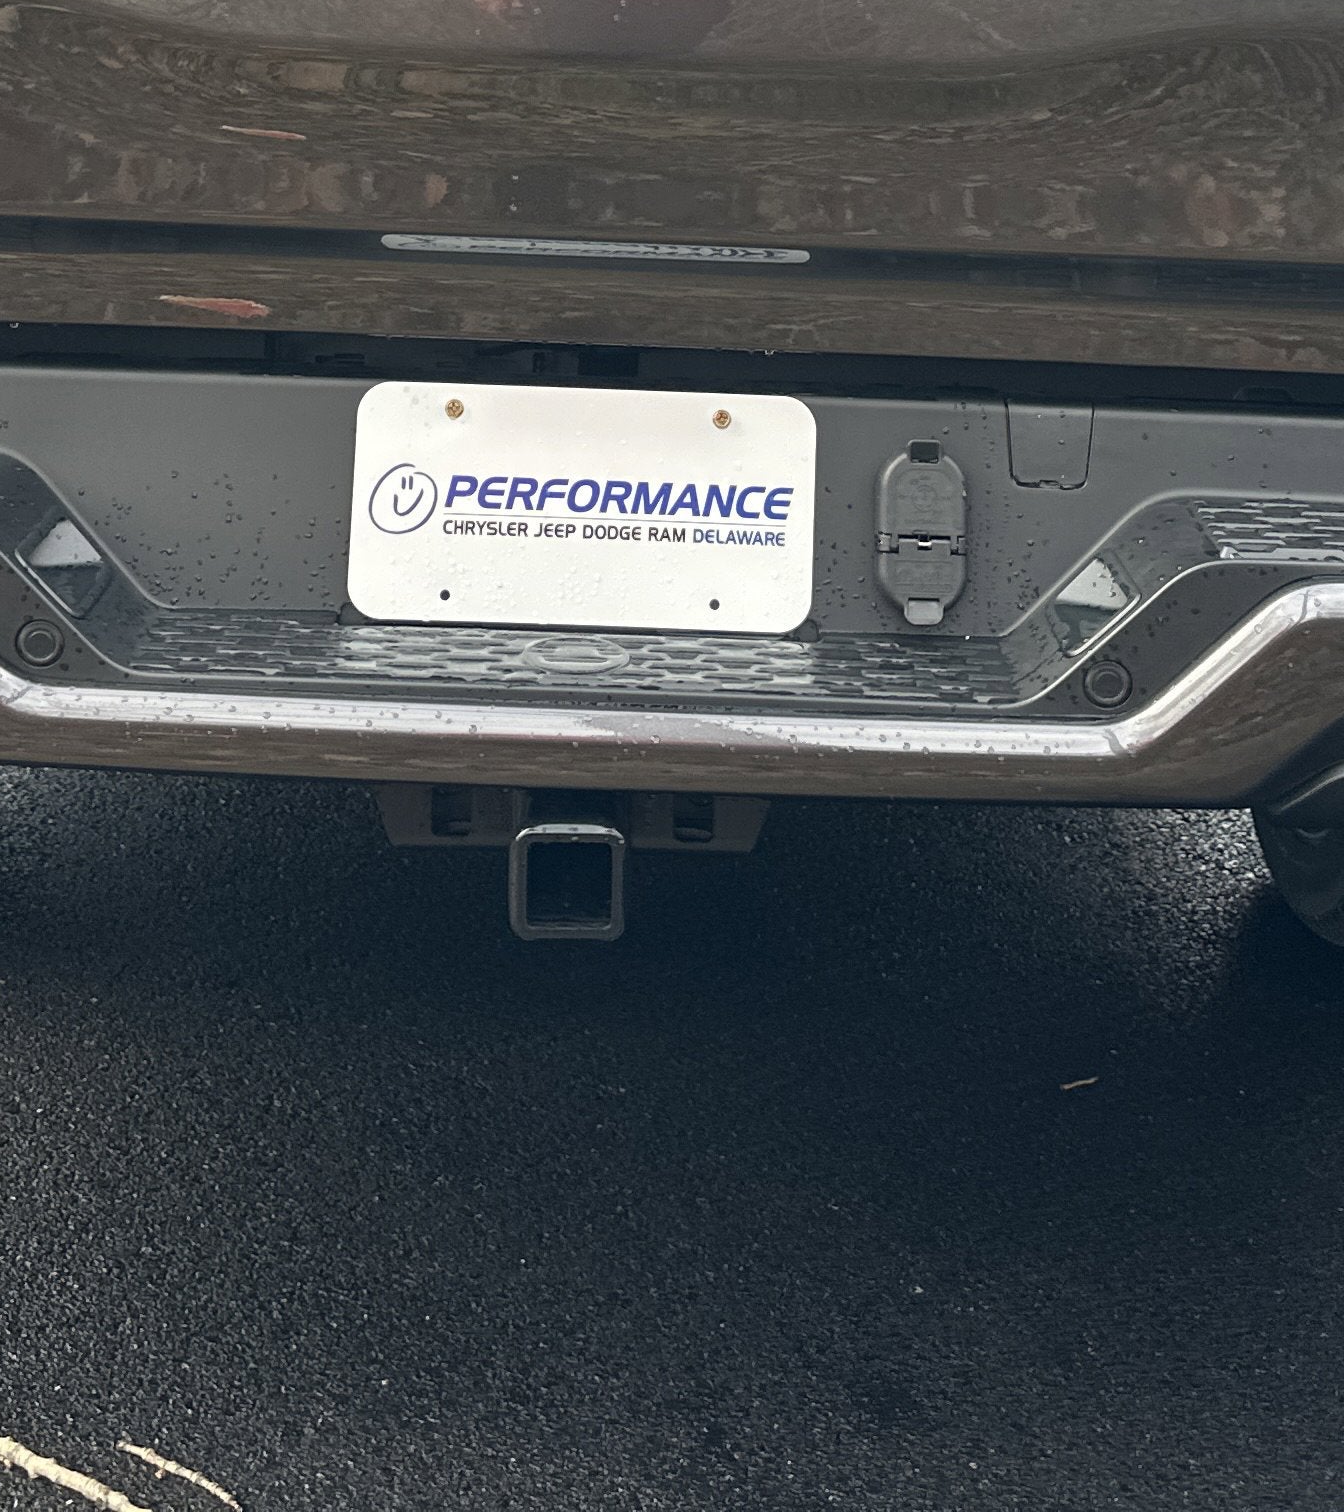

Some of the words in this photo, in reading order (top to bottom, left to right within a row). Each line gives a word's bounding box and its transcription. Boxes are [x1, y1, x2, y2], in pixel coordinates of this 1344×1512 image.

[444, 474, 794, 520] PERFORMANCE
[442, 519, 529, 537] CHRYSLER
[534, 523, 576, 539] JEEP
[582, 526, 642, 541] DODGE
[648, 528, 687, 543] RAM
[692, 528, 786, 547] DELAWARE
